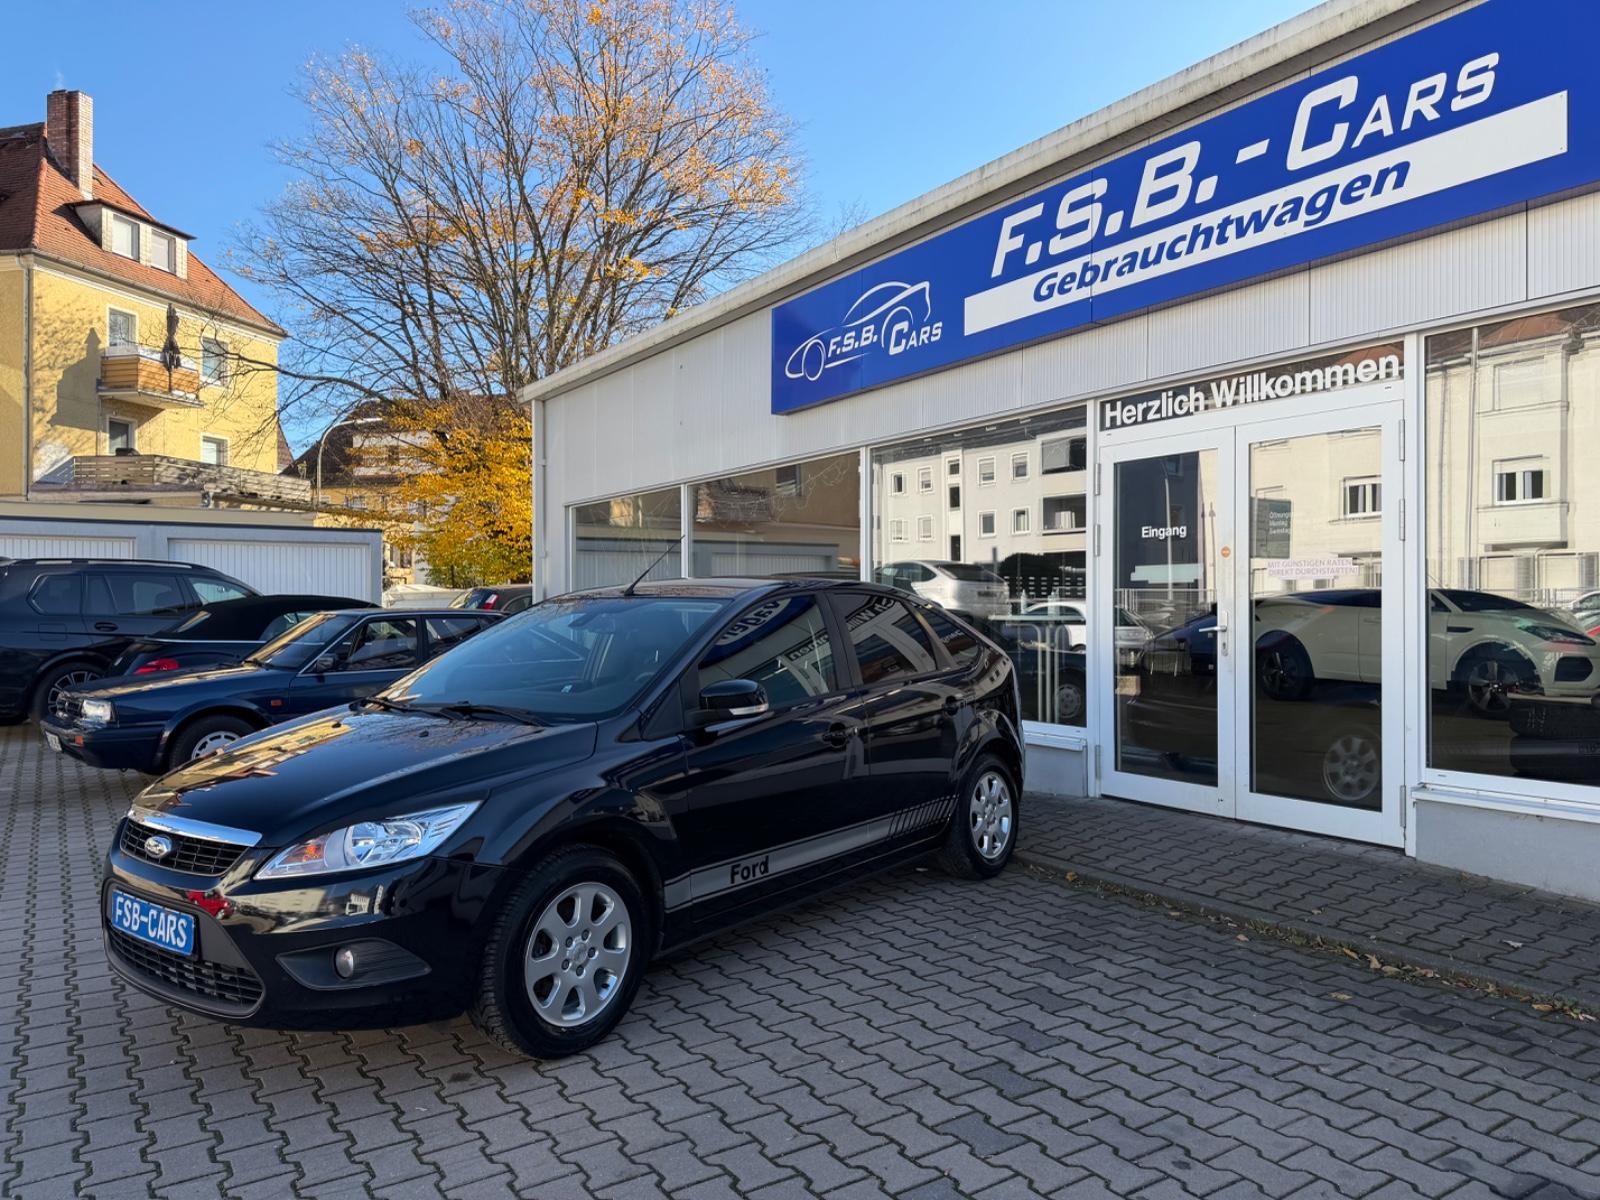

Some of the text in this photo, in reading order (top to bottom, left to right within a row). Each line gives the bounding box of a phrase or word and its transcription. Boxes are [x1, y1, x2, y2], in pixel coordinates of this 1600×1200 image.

[1033, 161, 1410, 303] Gebrauchtwagen
[827, 325, 878, 358] F.S.B.
[1105, 353, 1400, 428] Herzlich Willkommen
[1141, 525, 1187, 539] Eingang
[730, 855, 769, 884] Ford
[115, 896, 187, 949] FSB-CARS
